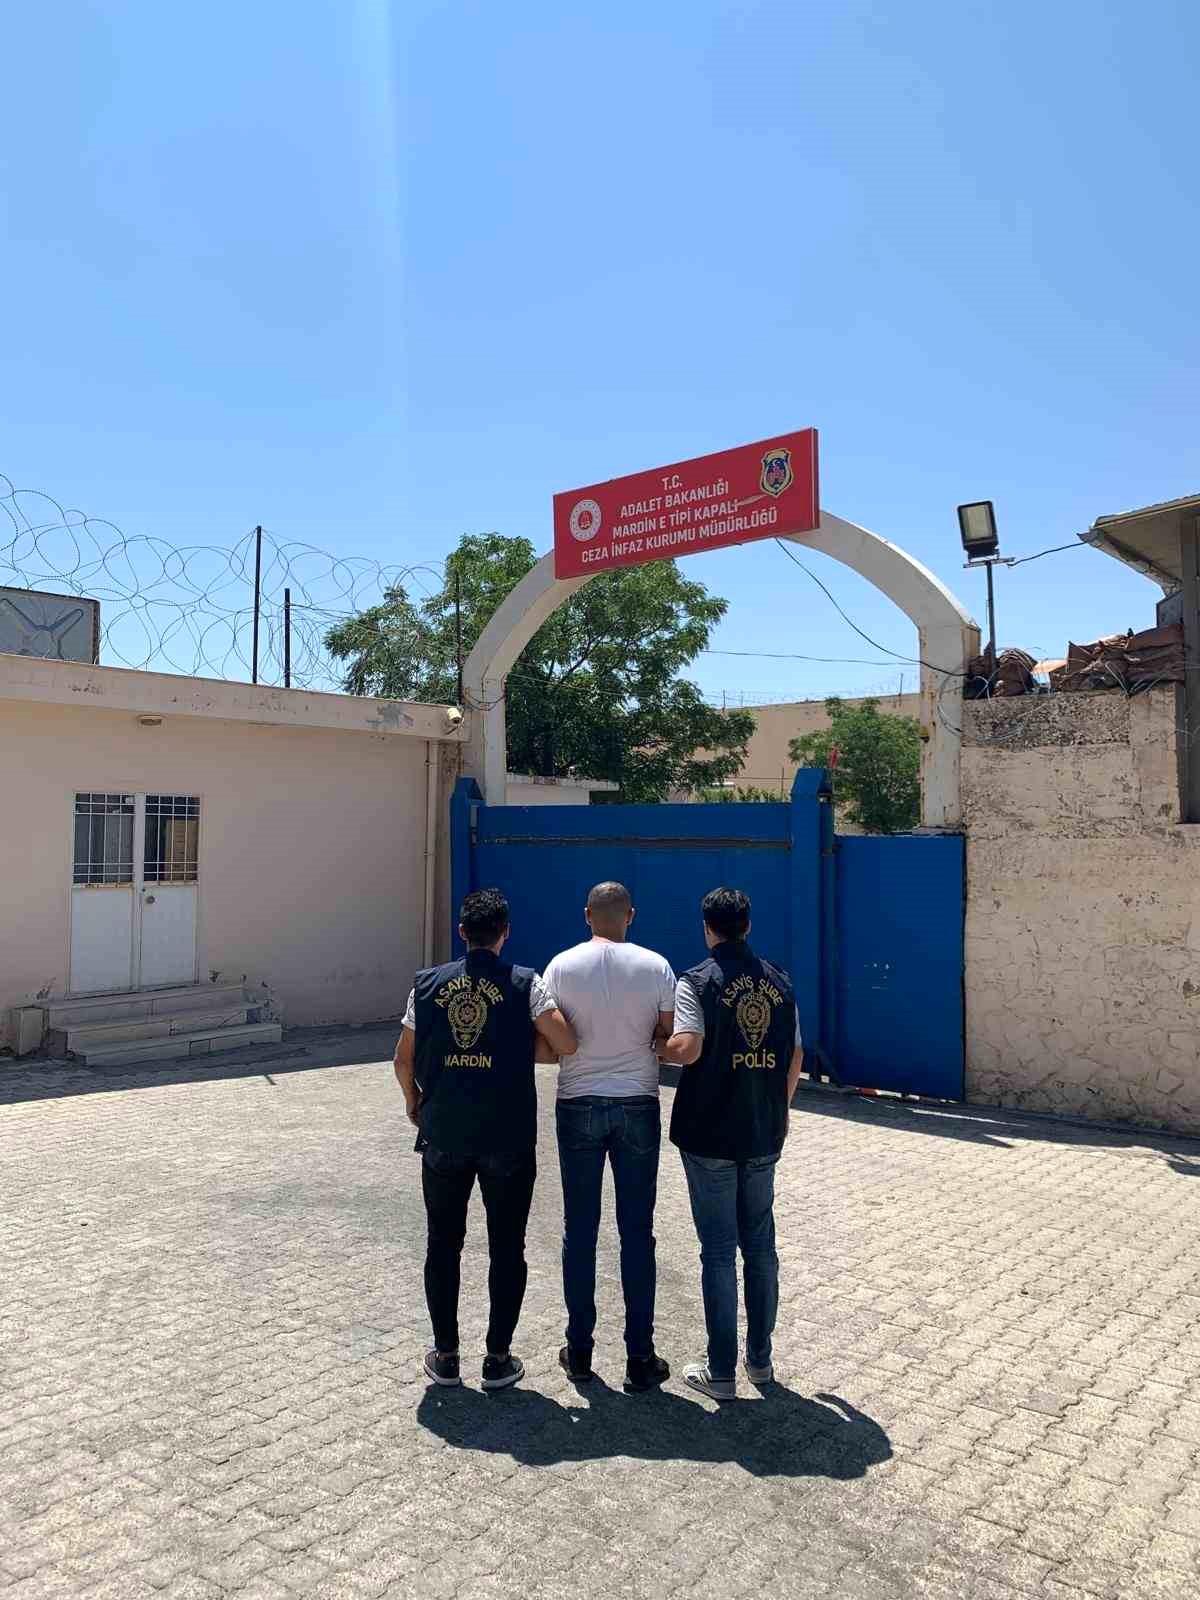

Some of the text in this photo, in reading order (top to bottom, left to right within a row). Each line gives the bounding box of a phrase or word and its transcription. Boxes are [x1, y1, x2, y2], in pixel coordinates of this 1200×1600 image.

[661, 474, 682, 490] T.C.
[621, 480, 729, 518] ADALET BAKANLIĞI
[582, 507, 778, 563] CEZA İNFAZ KURUMU MÜDÜRLÜĞÜ
[612, 519, 657, 540] MARDİN
[659, 516, 667, 529] E
[669, 508, 692, 526] TİPİ
[732, 1049, 777, 1070] POLİS
